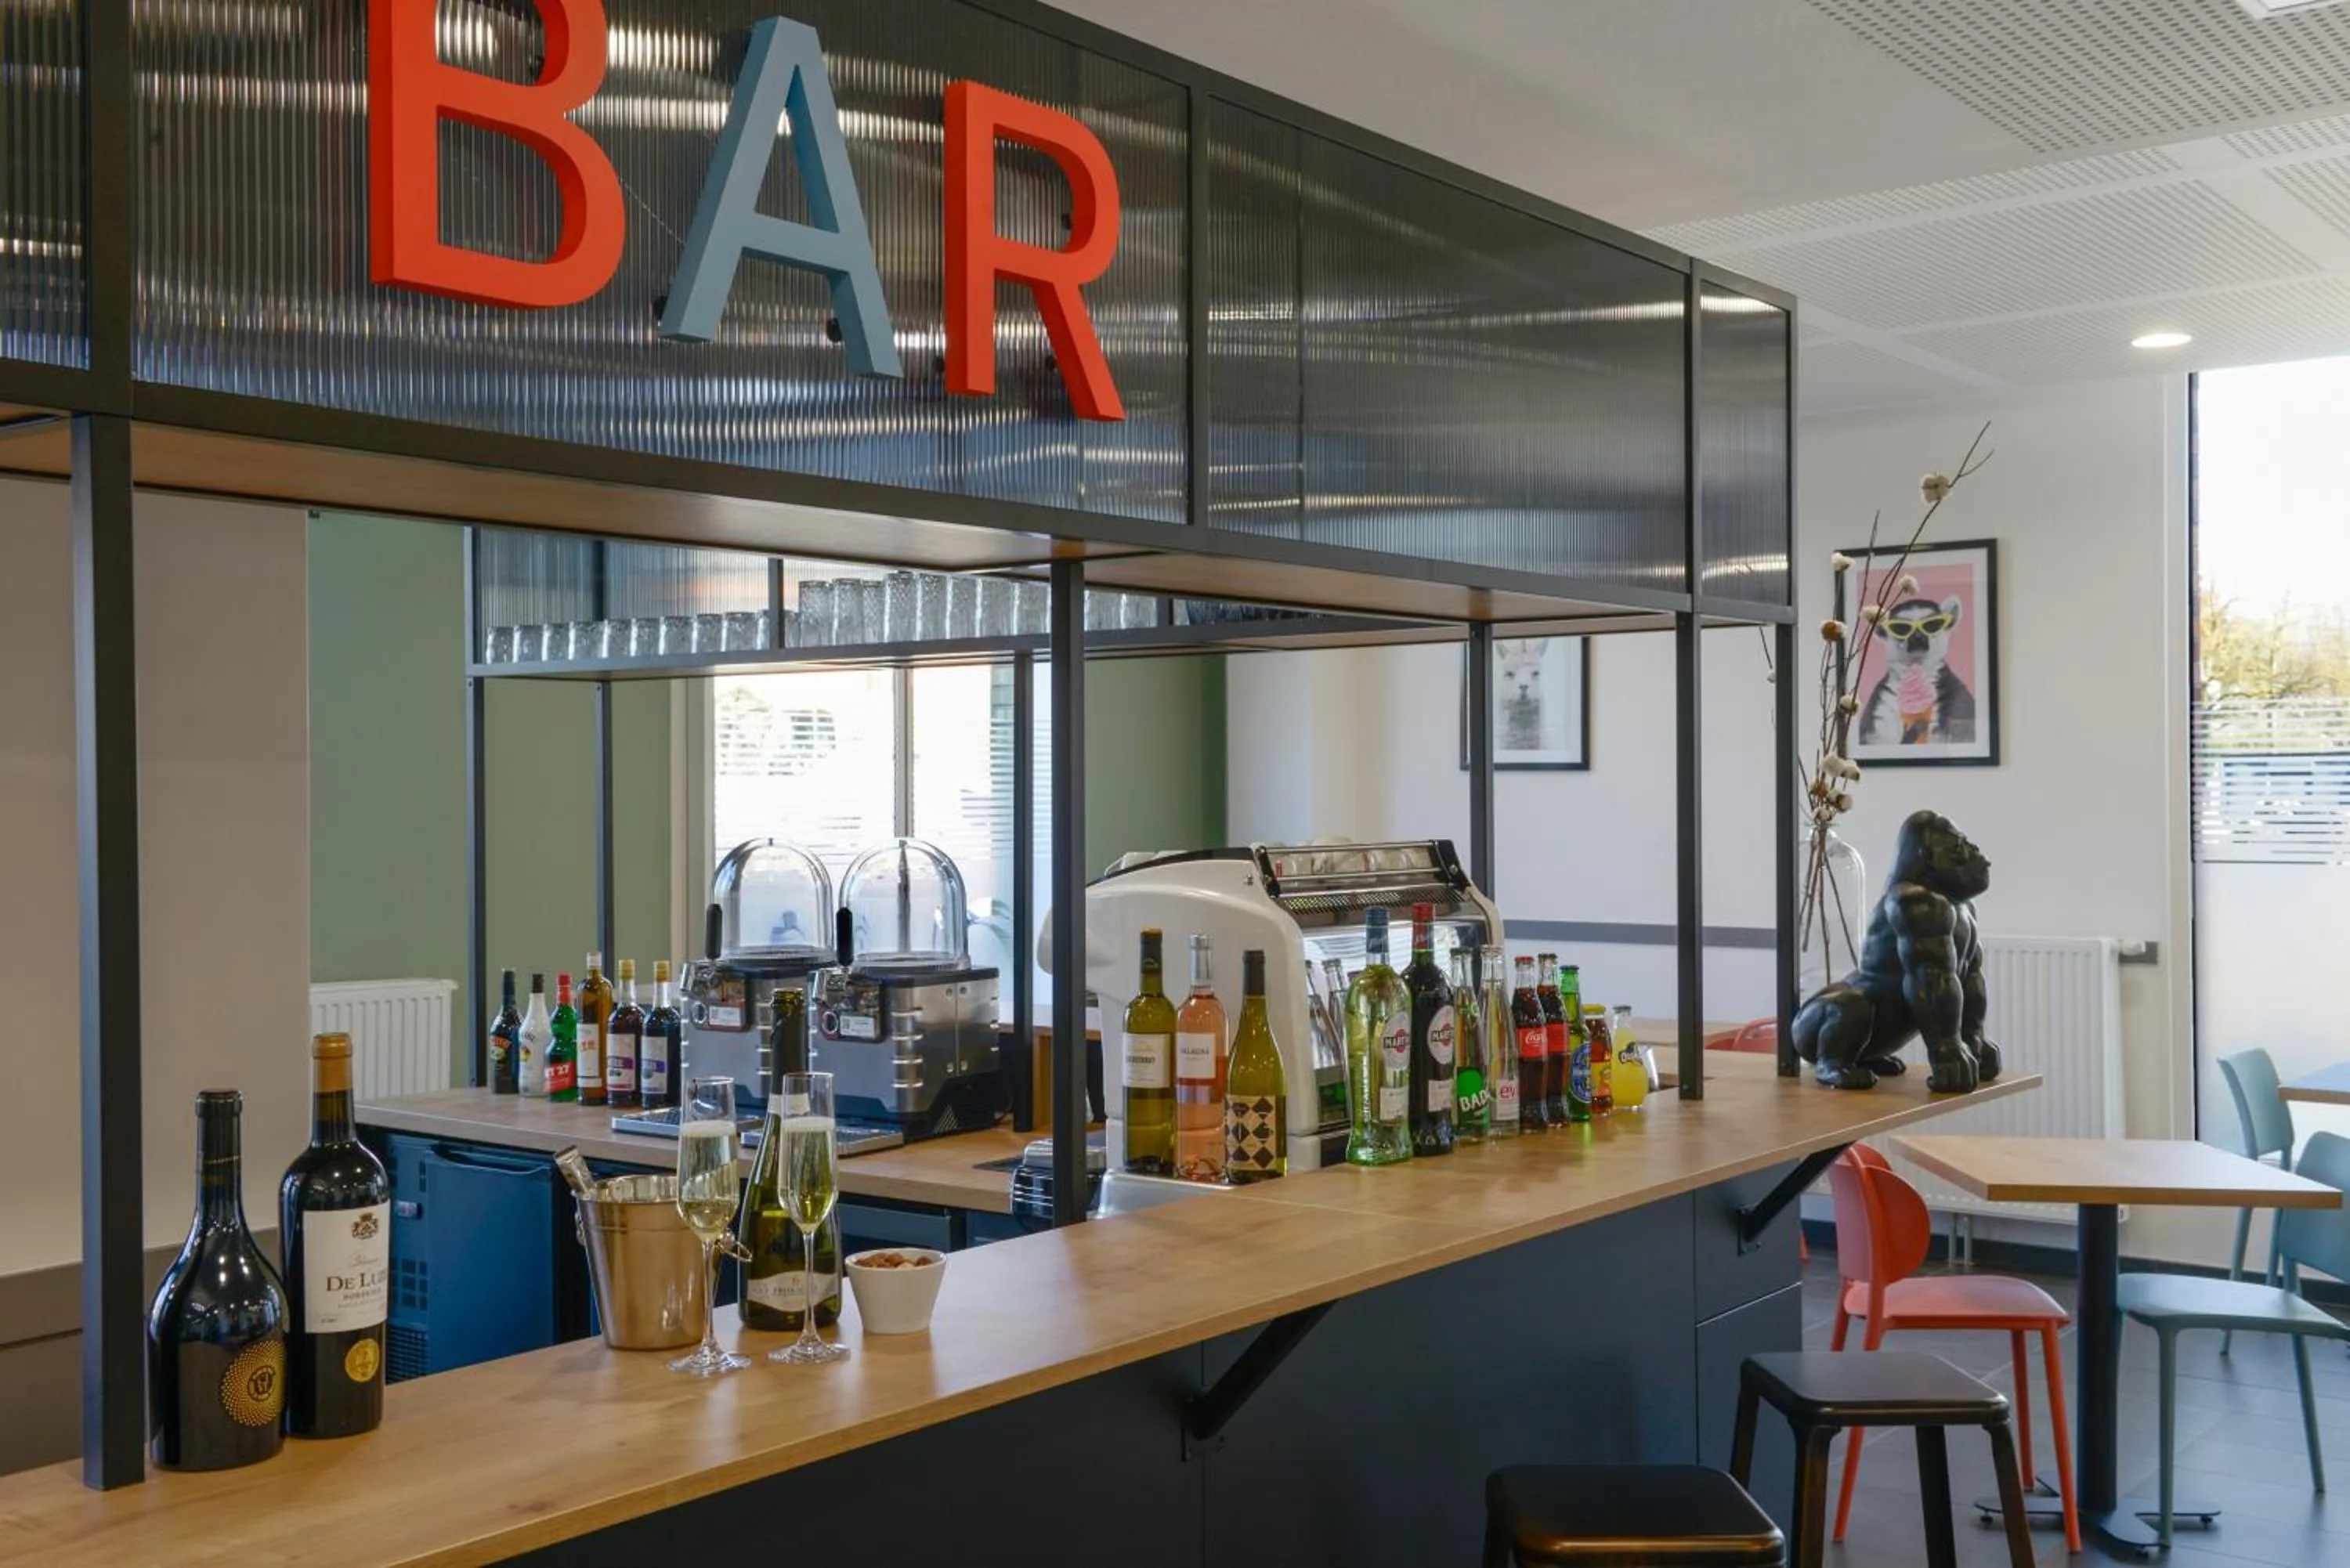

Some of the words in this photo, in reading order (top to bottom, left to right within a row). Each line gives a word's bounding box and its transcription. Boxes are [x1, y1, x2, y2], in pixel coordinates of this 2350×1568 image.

[369, 0, 1126, 421] BAR
[1384, 1036, 1410, 1048] MART
[1459, 1089, 1491, 1112] BAD
